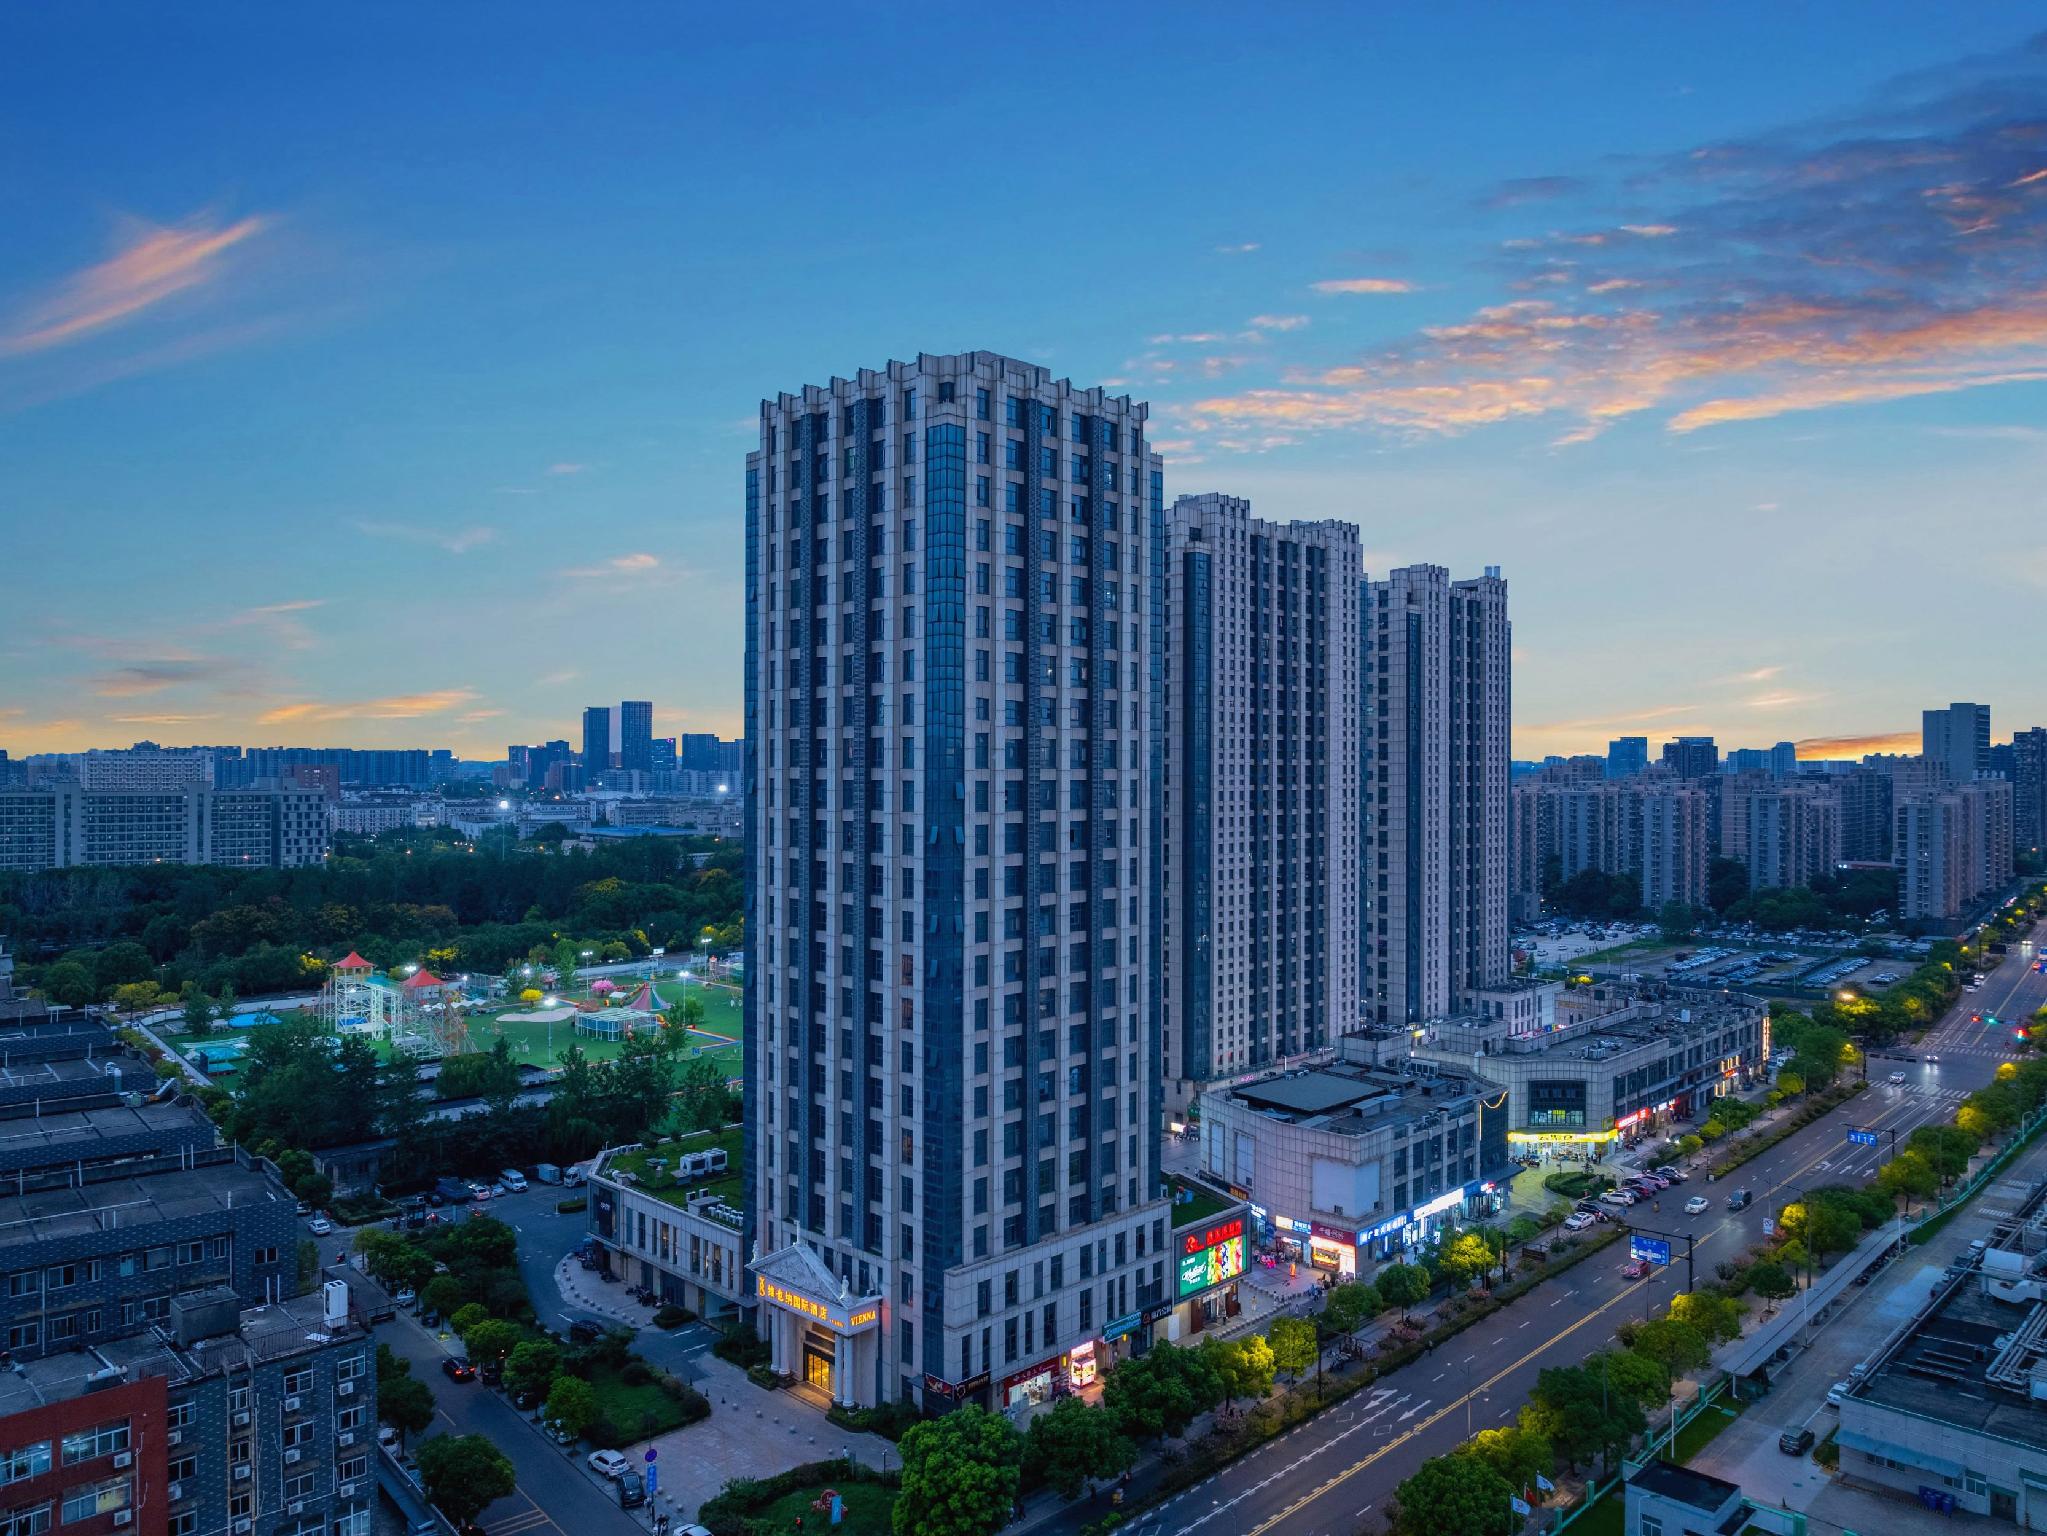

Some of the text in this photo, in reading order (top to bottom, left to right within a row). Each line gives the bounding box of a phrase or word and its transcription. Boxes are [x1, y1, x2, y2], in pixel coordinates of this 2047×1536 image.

[767, 1284, 828, 1320] 维也纳国际酒店
[850, 1310, 876, 1327] VIENNA
